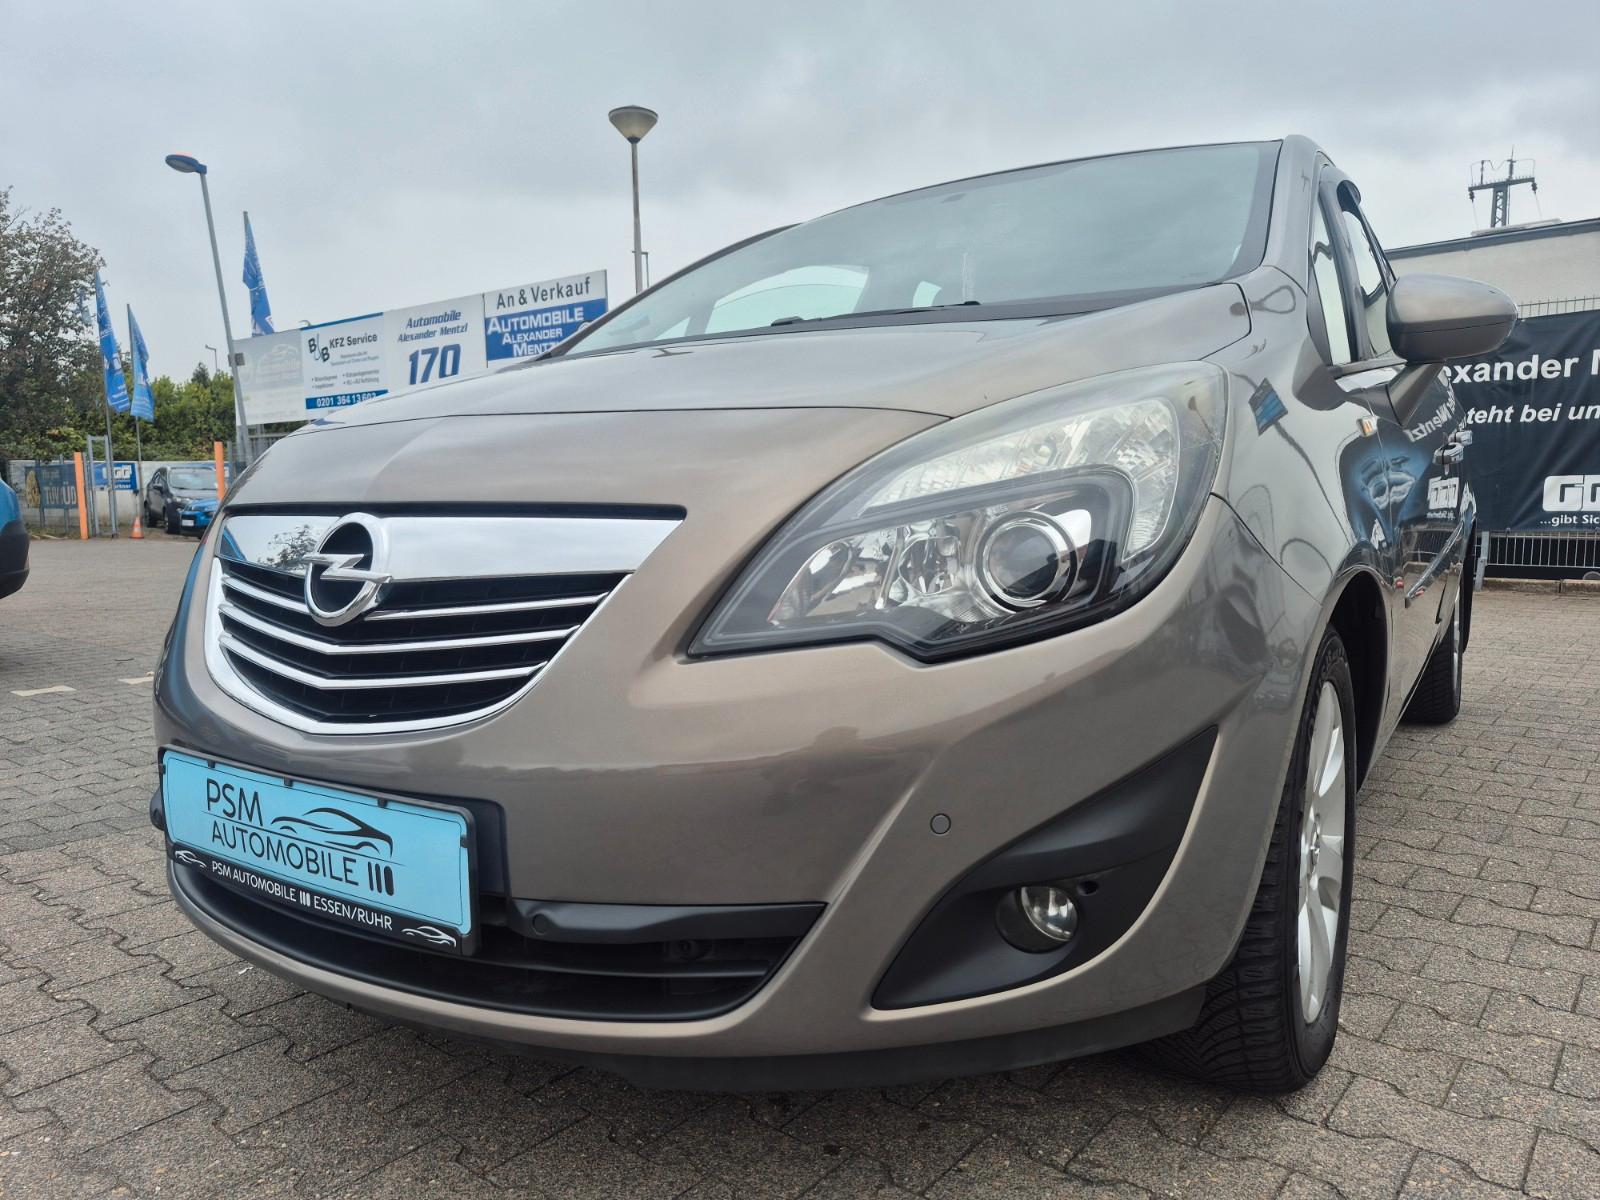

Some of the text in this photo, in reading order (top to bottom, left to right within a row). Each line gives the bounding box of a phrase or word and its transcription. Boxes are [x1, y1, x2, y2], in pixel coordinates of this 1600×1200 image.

[497, 276, 590, 309] An & Verkauf
[406, 309, 461, 328] Automobile
[487, 307, 584, 335] AUTOMOBILE
[329, 332, 378, 349] KFZ Service
[398, 322, 469, 343] Alexander Mentzl
[502, 327, 562, 345] ALEXANDER
[513, 341, 559, 357] MENT
[409, 343, 461, 385] 170
[316, 397, 334, 407] 0201
[1520, 403, 1562, 423] bei
[207, 778, 263, 826] PSM
[212, 820, 359, 886] AUTOMOBILE
[212, 861, 231, 878] PSM
[232, 870, 297, 902] AUTOMOBILE
[314, 896, 393, 931] ESSEN/RUHR
